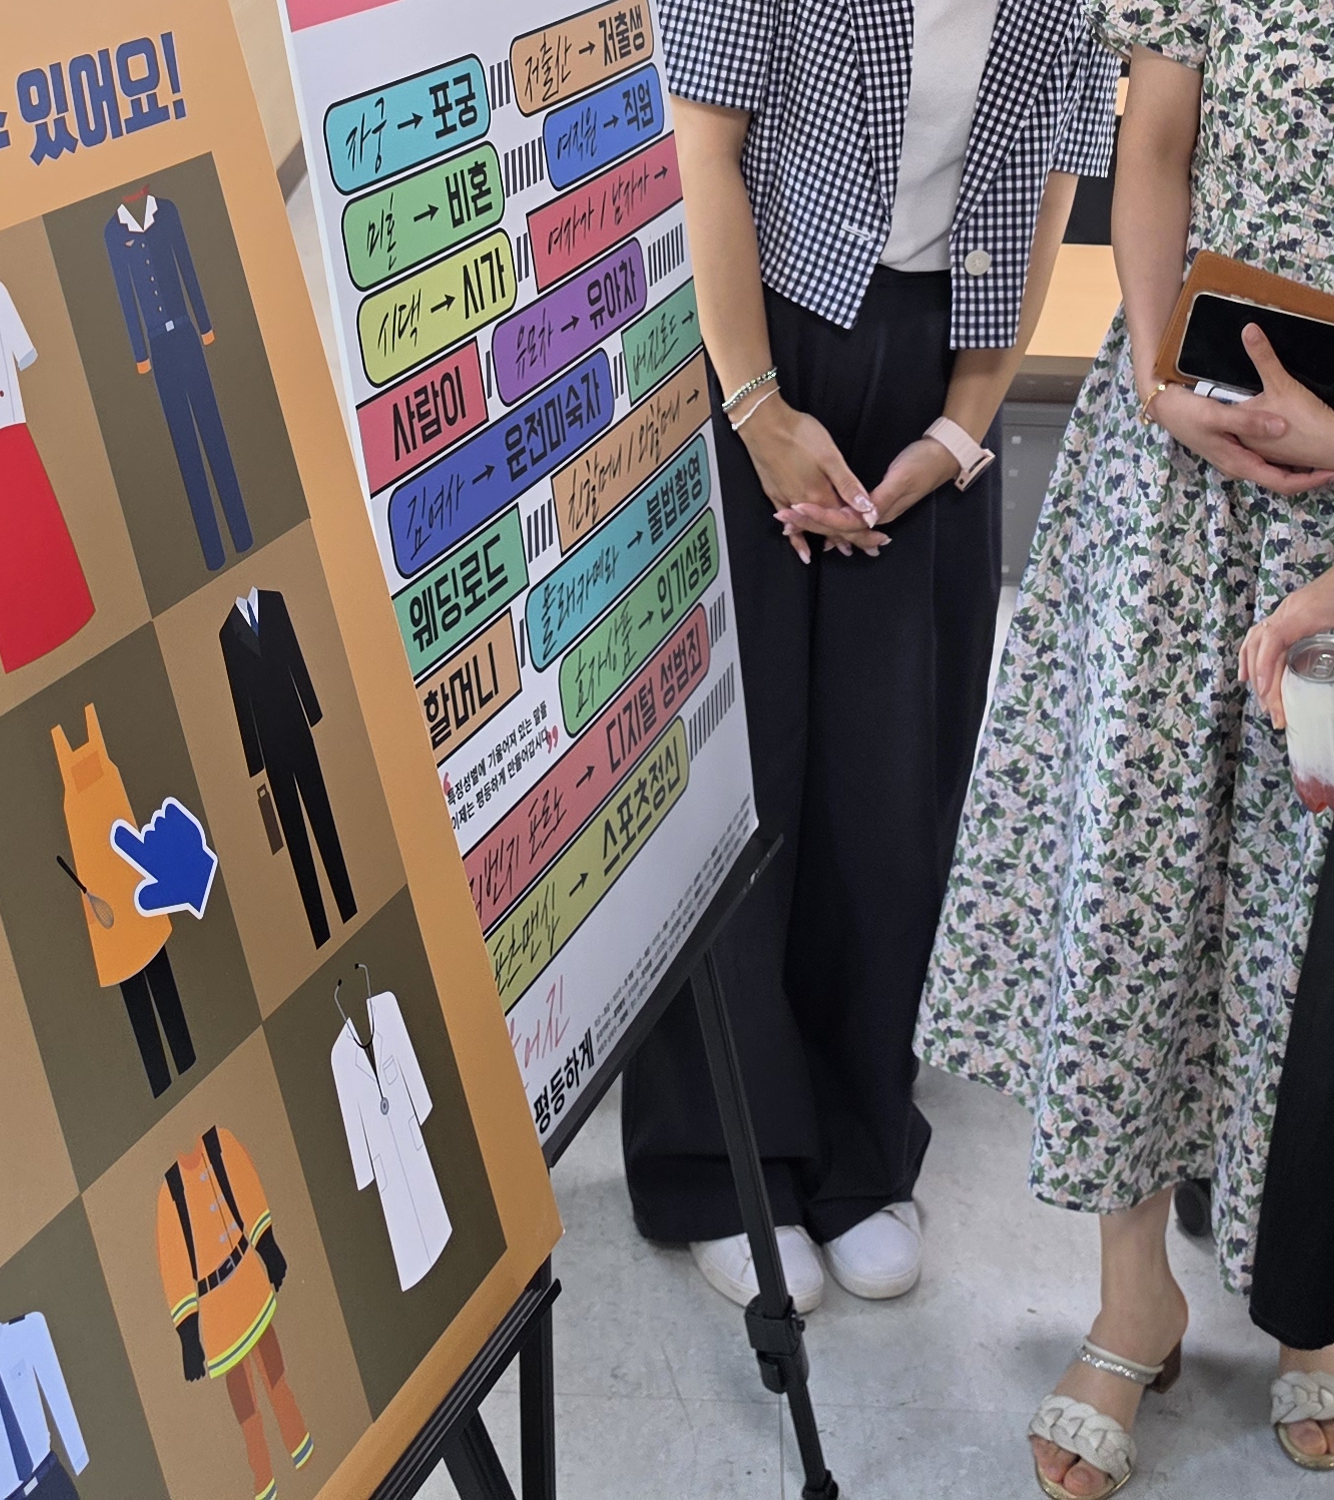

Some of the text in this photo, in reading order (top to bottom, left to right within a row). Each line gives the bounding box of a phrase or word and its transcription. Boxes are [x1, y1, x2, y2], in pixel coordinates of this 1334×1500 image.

[15, 32, 187, 167] 있어요!
[525, 5, 645, 102] 저출산 저출생
[345, 72, 477, 174] 자궁 포궁
[557, 80, 654, 161] 여직원 직원
[367, 161, 493, 271] 미혼 비혼
[378, 247, 506, 357] 시댁 시가
[515, 257, 637, 379] 유모차 유아차
[633, 312, 679, 386] 버진로드
[392, 366, 466, 462] 사람이
[406, 368, 601, 561] 김여사 운전미숙자
[568, 443, 622, 533] 친할머니
[638, 391, 680, 464] 외할머니
[409, 533, 508, 653] 웨딩로드
[541, 451, 703, 661] 몰래카메라 불법촬영
[575, 526, 712, 718] 효자상품 인기상품
[424, 641, 499, 750] 할머니
[488, 730, 518, 768] 기울어져
[517, 718, 533, 742] 있는
[528, 786, 567, 864] 포르노
[606, 677, 657, 774] 디지털
[660, 622, 702, 708] 성범죄
[451, 726, 549, 831] 이제는 평등하게 만들어갑시다
[602, 735, 681, 877] 스포츠정신
[533, 1027, 595, 1134] 평등하게
